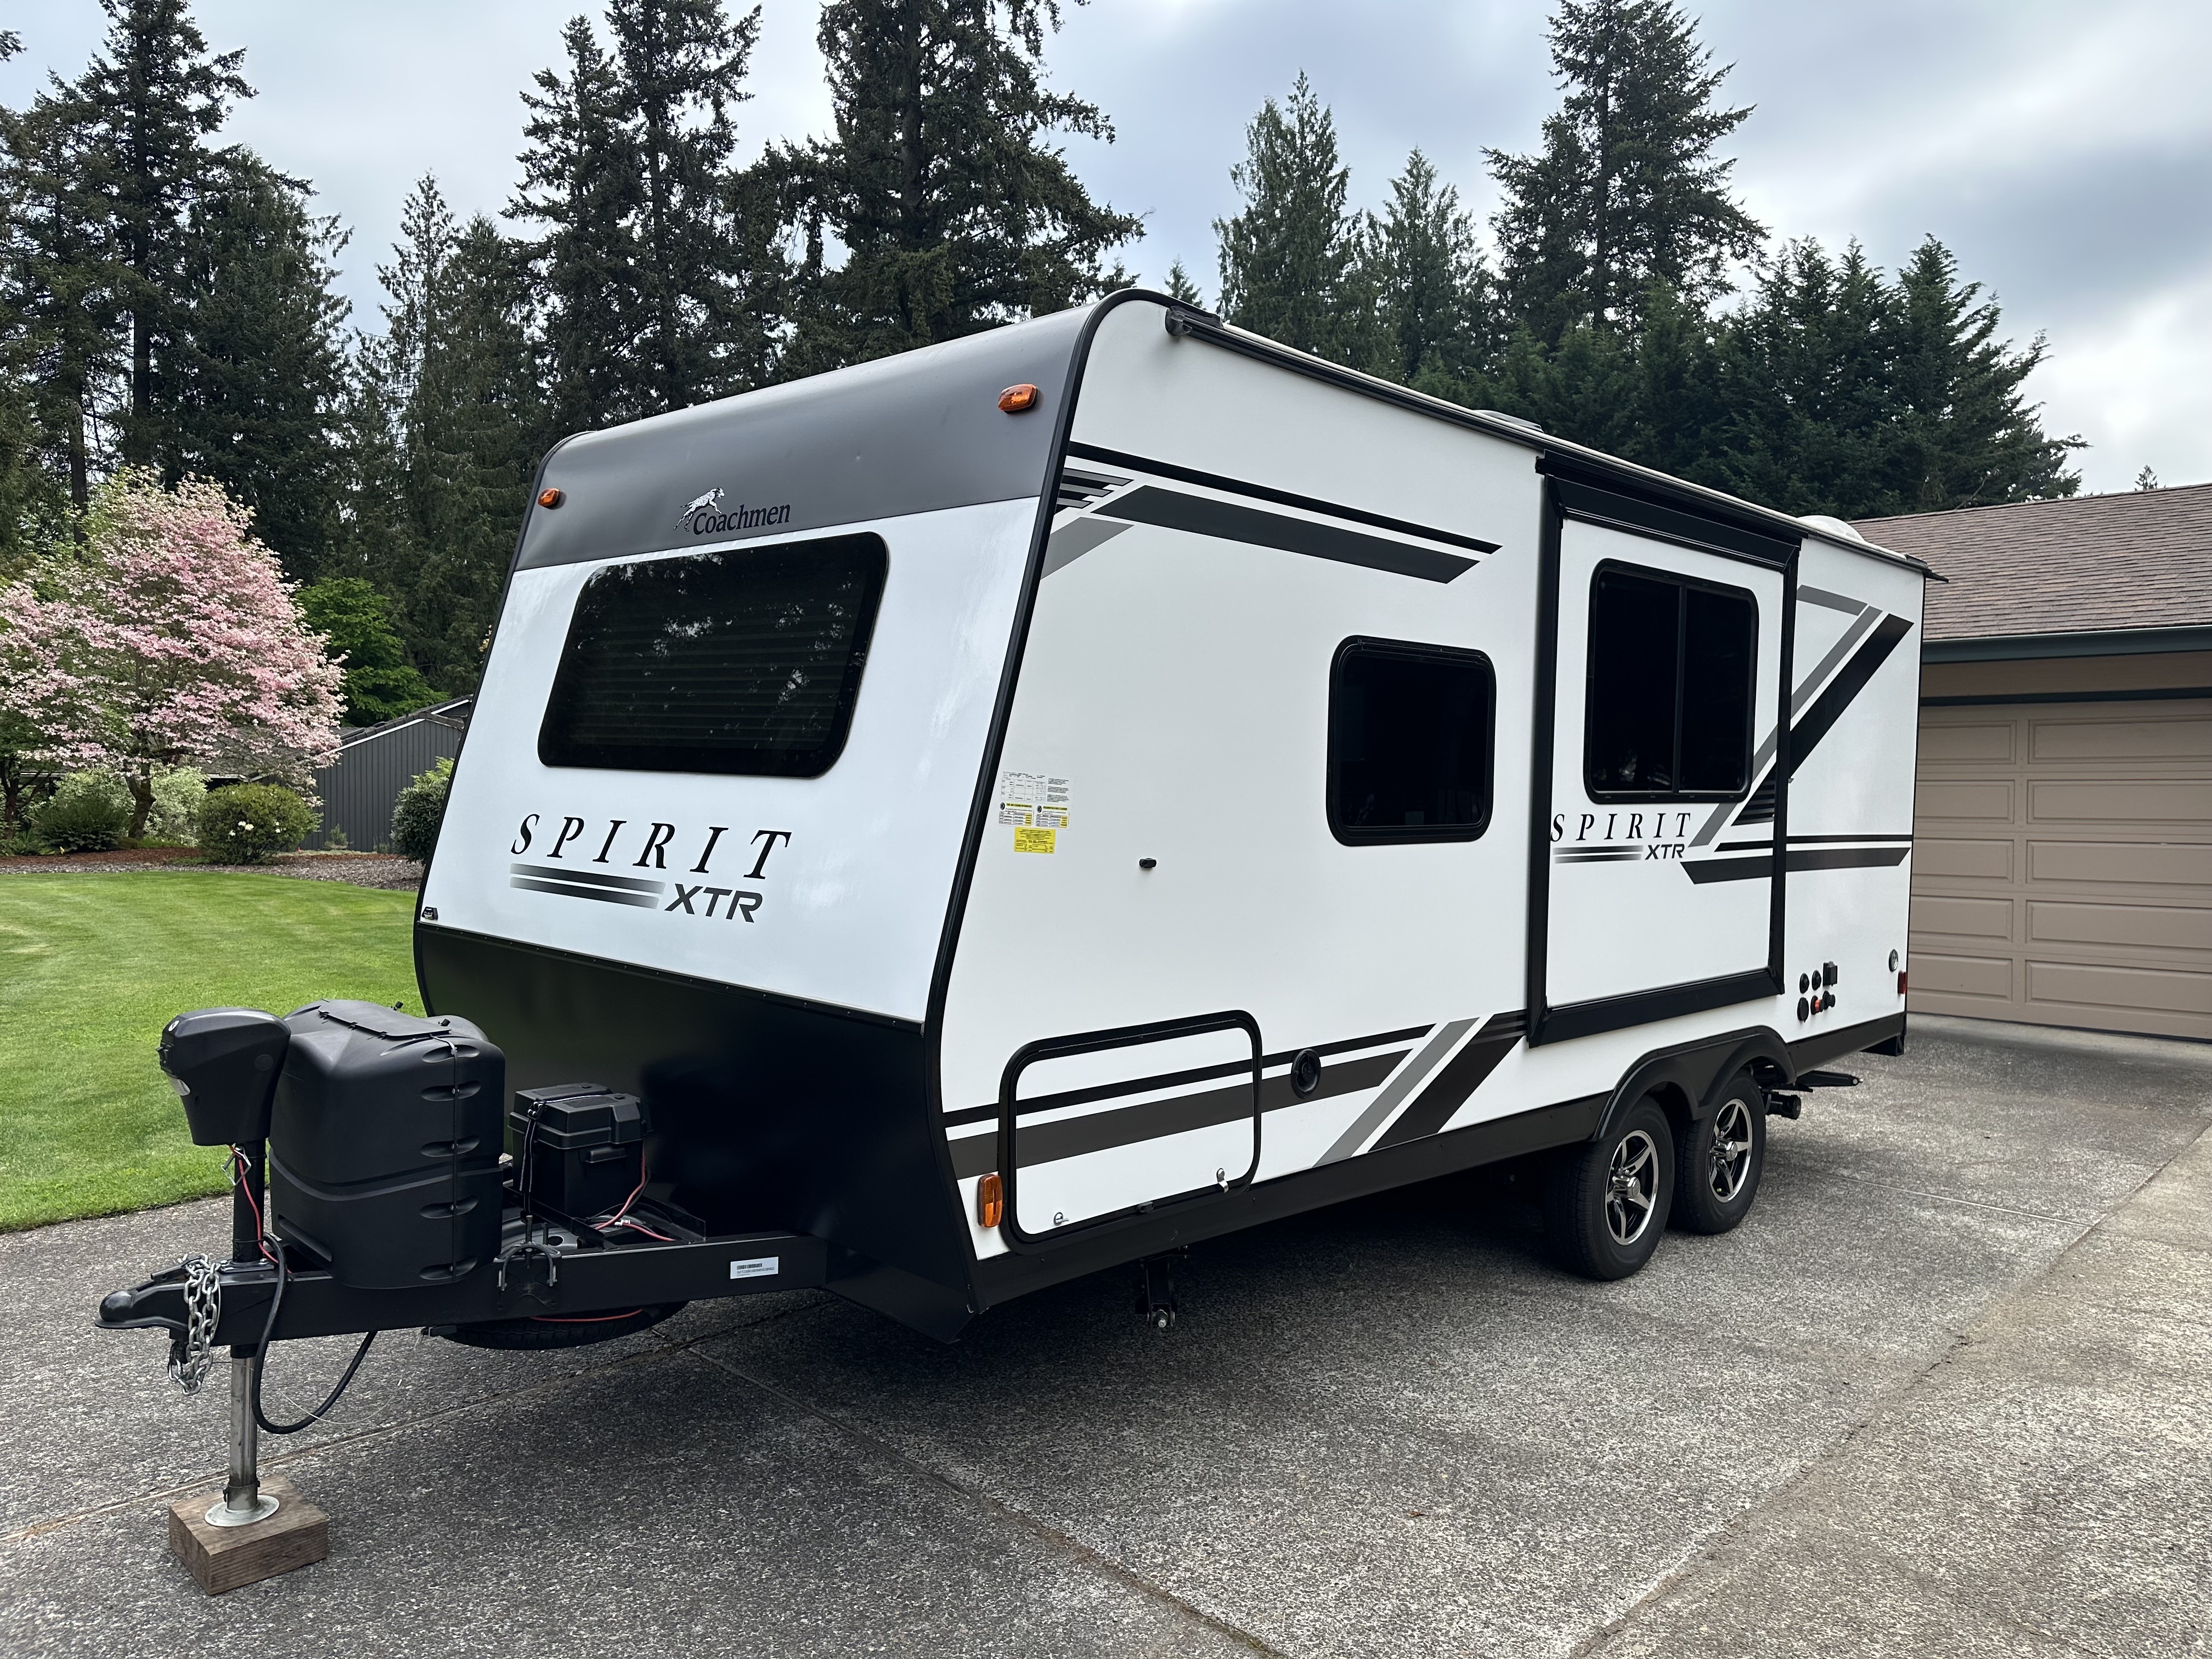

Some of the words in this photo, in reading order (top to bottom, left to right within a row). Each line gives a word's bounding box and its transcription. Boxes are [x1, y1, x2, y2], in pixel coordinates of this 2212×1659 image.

[693, 504, 791, 535] Coachmen
[1550, 812, 1691, 842] SPIRIT
[510, 814, 792, 880] SPIRIT
[1645, 843, 1685, 860] XTR
[664, 883, 763, 923] XTR
